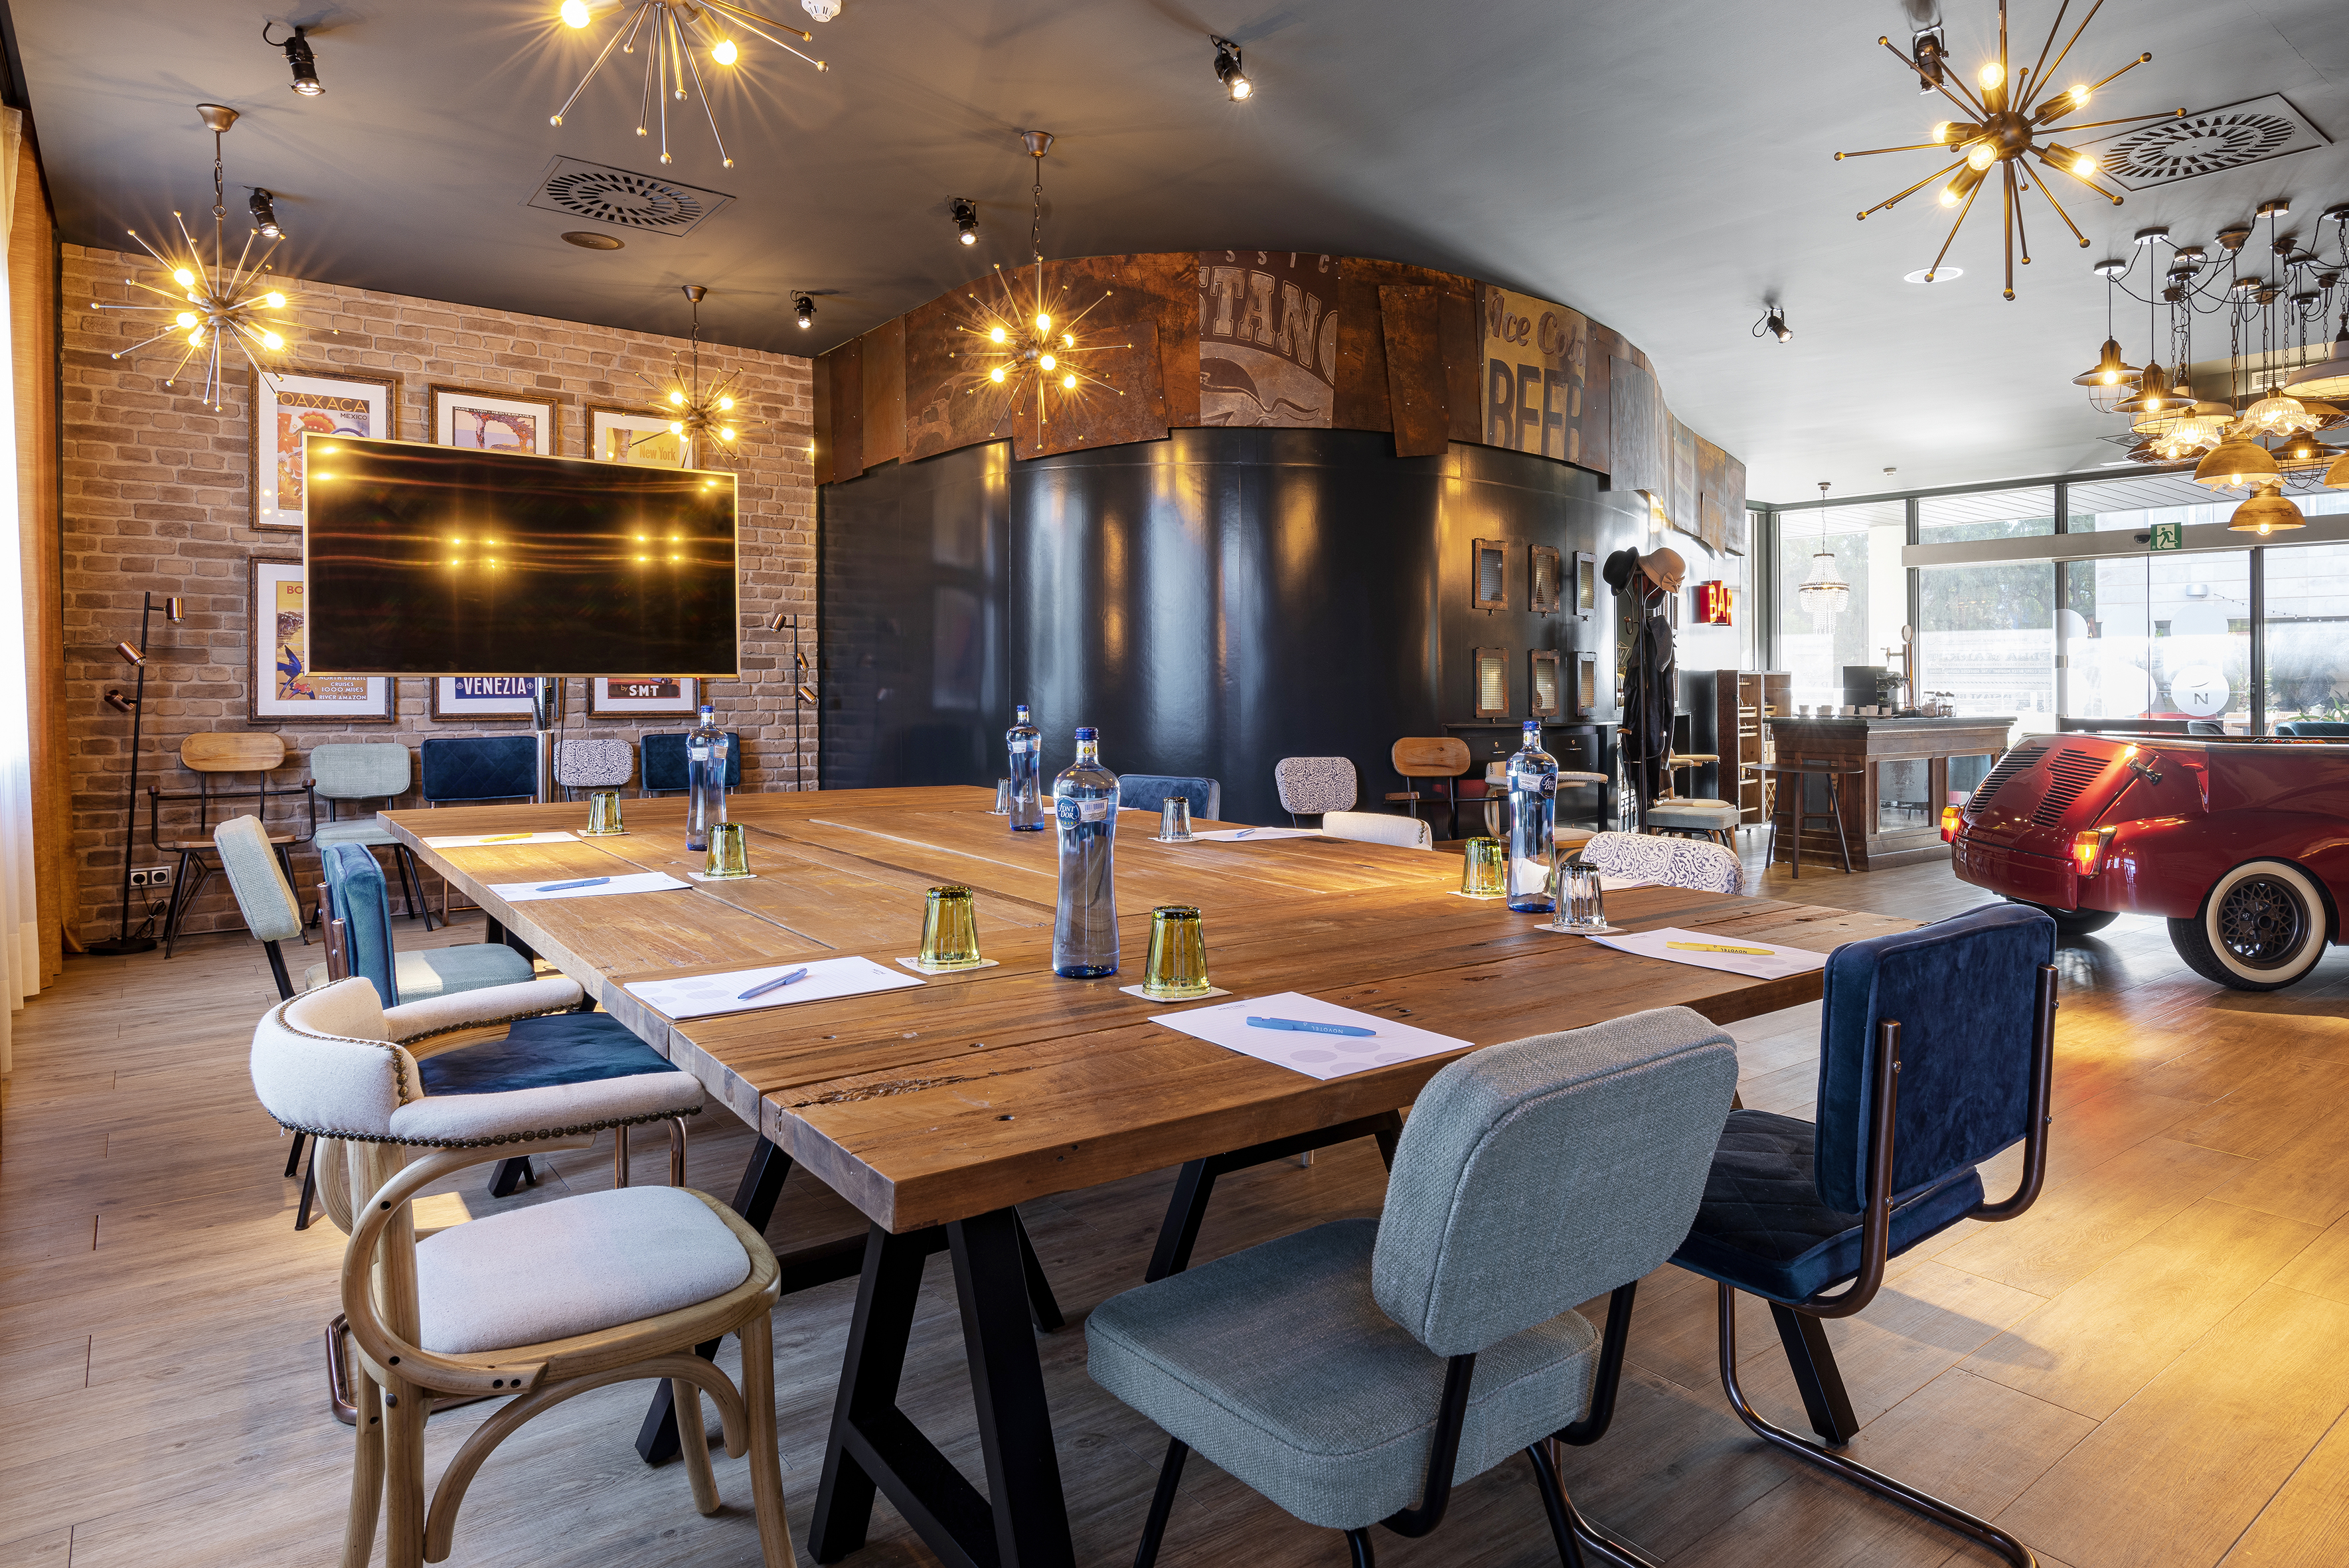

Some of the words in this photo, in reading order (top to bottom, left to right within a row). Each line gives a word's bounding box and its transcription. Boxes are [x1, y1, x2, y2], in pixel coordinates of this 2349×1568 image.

[1491, 293, 1531, 347] Ice
[280, 392, 367, 413] OAXACA
[1487, 358, 1584, 461] BEER
[639, 445, 657, 459] New
[659, 447, 676, 461] York
[1708, 580, 1733, 627] BAR
[463, 677, 527, 695] VENEZIA
[758, 984, 775, 993] NOVOTEL
[1311, 1026, 1343, 1034] NOVOTEL
